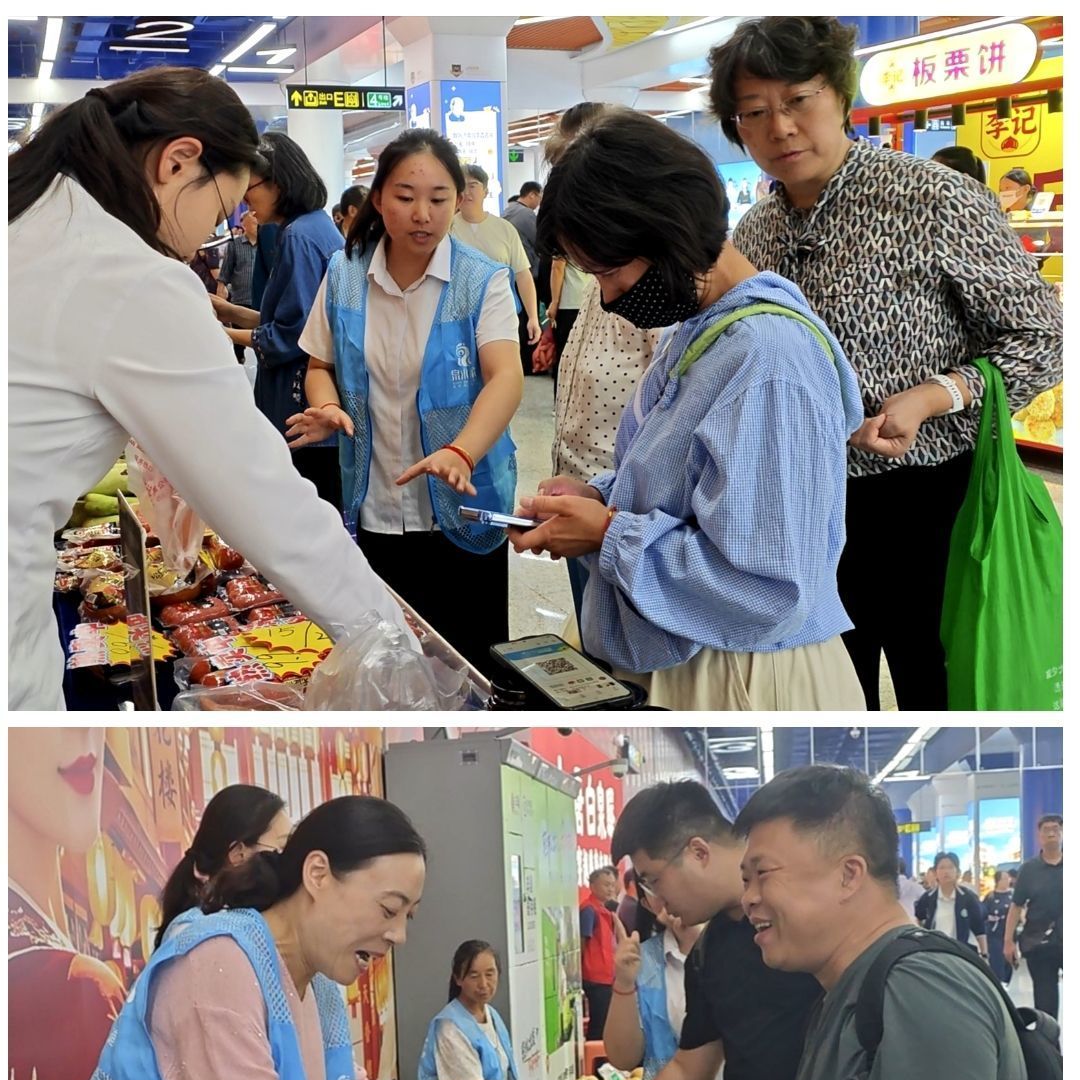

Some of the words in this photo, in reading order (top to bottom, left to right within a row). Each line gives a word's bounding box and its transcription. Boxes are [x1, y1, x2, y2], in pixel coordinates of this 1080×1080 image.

[912, 39, 1006, 87] 板栗饼
[334, 91, 344, 106] E
[985, 105, 1038, 140] 李记
